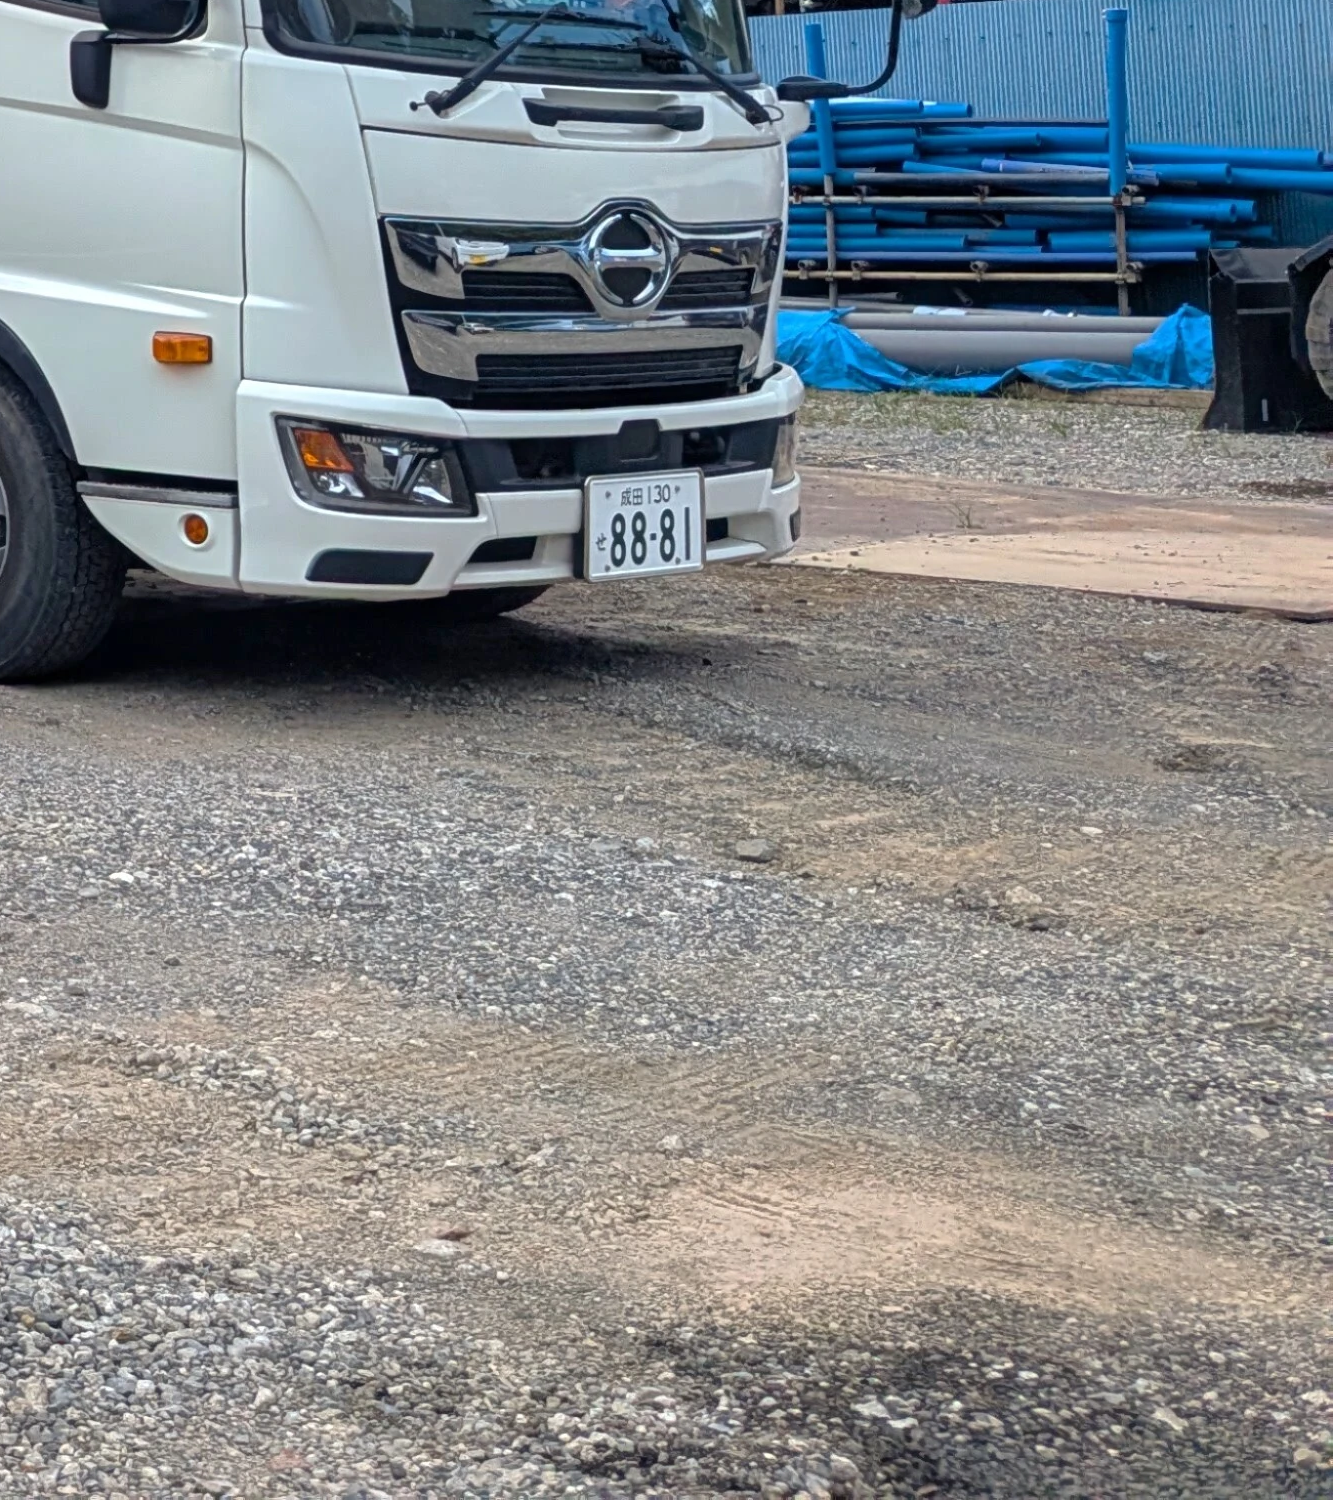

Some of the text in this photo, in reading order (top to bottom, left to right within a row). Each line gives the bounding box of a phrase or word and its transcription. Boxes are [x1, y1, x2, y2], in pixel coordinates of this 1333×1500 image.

[620, 483, 671, 506] 成田 130
[596, 507, 691, 567] せ 88-81
